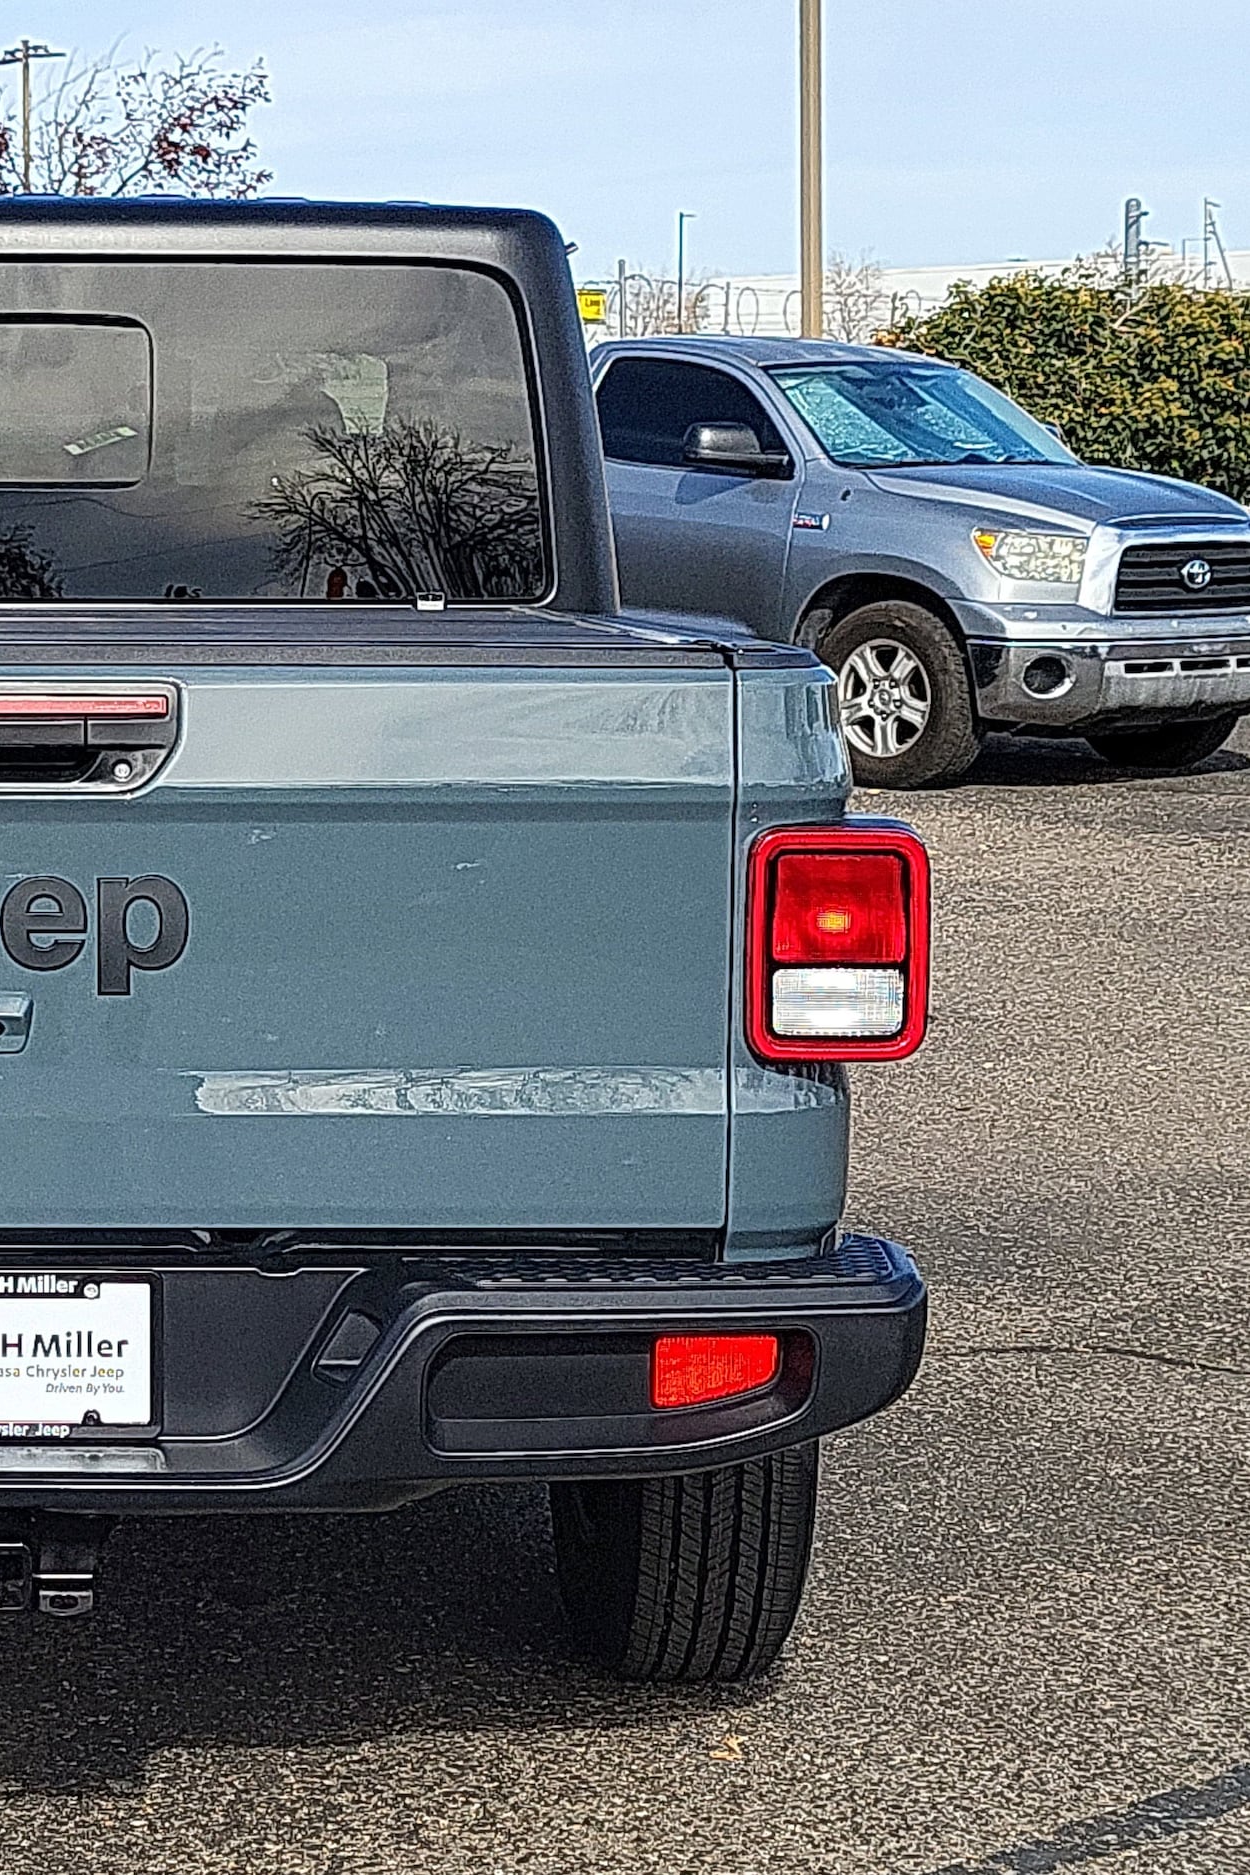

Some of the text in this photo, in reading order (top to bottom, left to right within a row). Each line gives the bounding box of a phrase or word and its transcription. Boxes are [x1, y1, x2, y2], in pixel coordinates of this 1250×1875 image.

[0, 1277, 14, 1294] H
[17, 1275, 79, 1294] Miller
[2, 1333, 23, 1358] H
[31, 1331, 129, 1358] Miller
[26, 1364, 87, 1380] Chrysler
[90, 1365, 125, 1380] Jeep
[45, 1382, 83, 1394] Driven
[86, 1383, 101, 1396] By
[35, 1422, 71, 1438] Jeep
